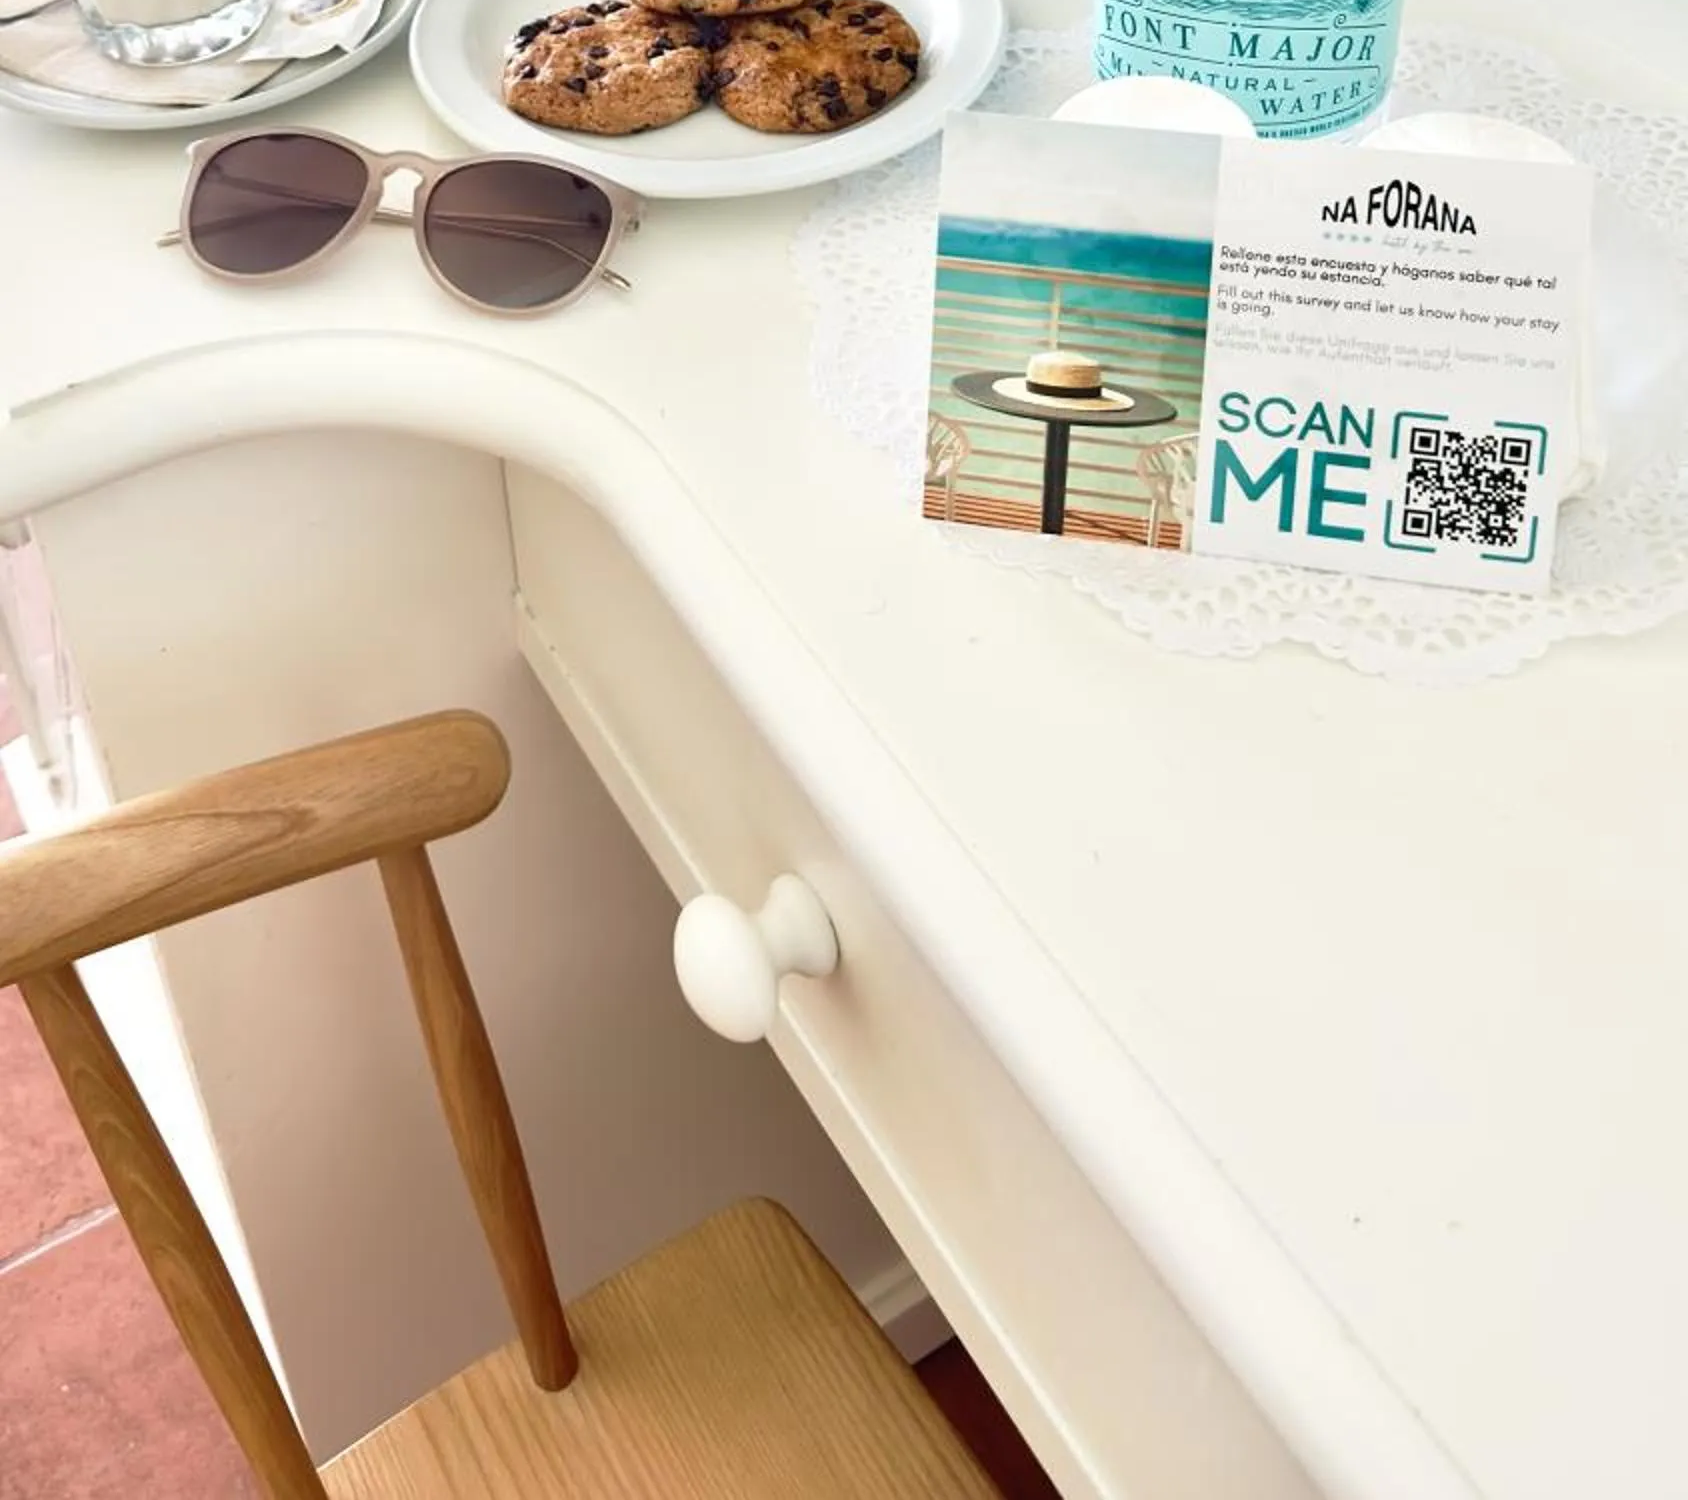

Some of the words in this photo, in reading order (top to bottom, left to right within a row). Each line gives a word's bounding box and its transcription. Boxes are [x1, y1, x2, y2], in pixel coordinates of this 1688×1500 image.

[1104, 3, 1197, 51] FONT
[1228, 31, 1377, 62] MAJOR
[1171, 64, 1295, 91] NATURAL
[1260, 80, 1361, 116] WATER
[1321, 195, 1358, 225] NA
[1366, 179, 1477, 235] FORANA
[1219, 260, 1249, 274] está
[1254, 264, 1297, 279] yendo
[1301, 270, 1317, 281] su
[1320, 271, 1386, 287] estancia.
[1220, 245, 1272, 263] Rellene
[1275, 253, 1307, 265] esta
[1311, 257, 1376, 273] encuesta
[1380, 264, 1389, 277] y
[1392, 262, 1455, 281] háganos
[1459, 270, 1500, 284] saber
[1503, 275, 1532, 289] qué
[1537, 276, 1558, 290] tal
[1216, 299, 1227, 310] is
[1231, 300, 1275, 318] going.
[1217, 283, 1238, 298] Fill
[1241, 288, 1264, 300] out
[1268, 289, 1293, 304] this
[1296, 295, 1340, 312] survey
[1344, 299, 1371, 312] and
[1375, 301, 1394, 314] let
[1399, 306, 1414, 316] us
[1418, 303, 1456, 320] know
[1459, 308, 1491, 323] how
[1494, 314, 1526, 328] your
[1529, 317, 1560, 333] stay
[1217, 391, 1375, 449] SCAN
[1209, 438, 1372, 542] ME
